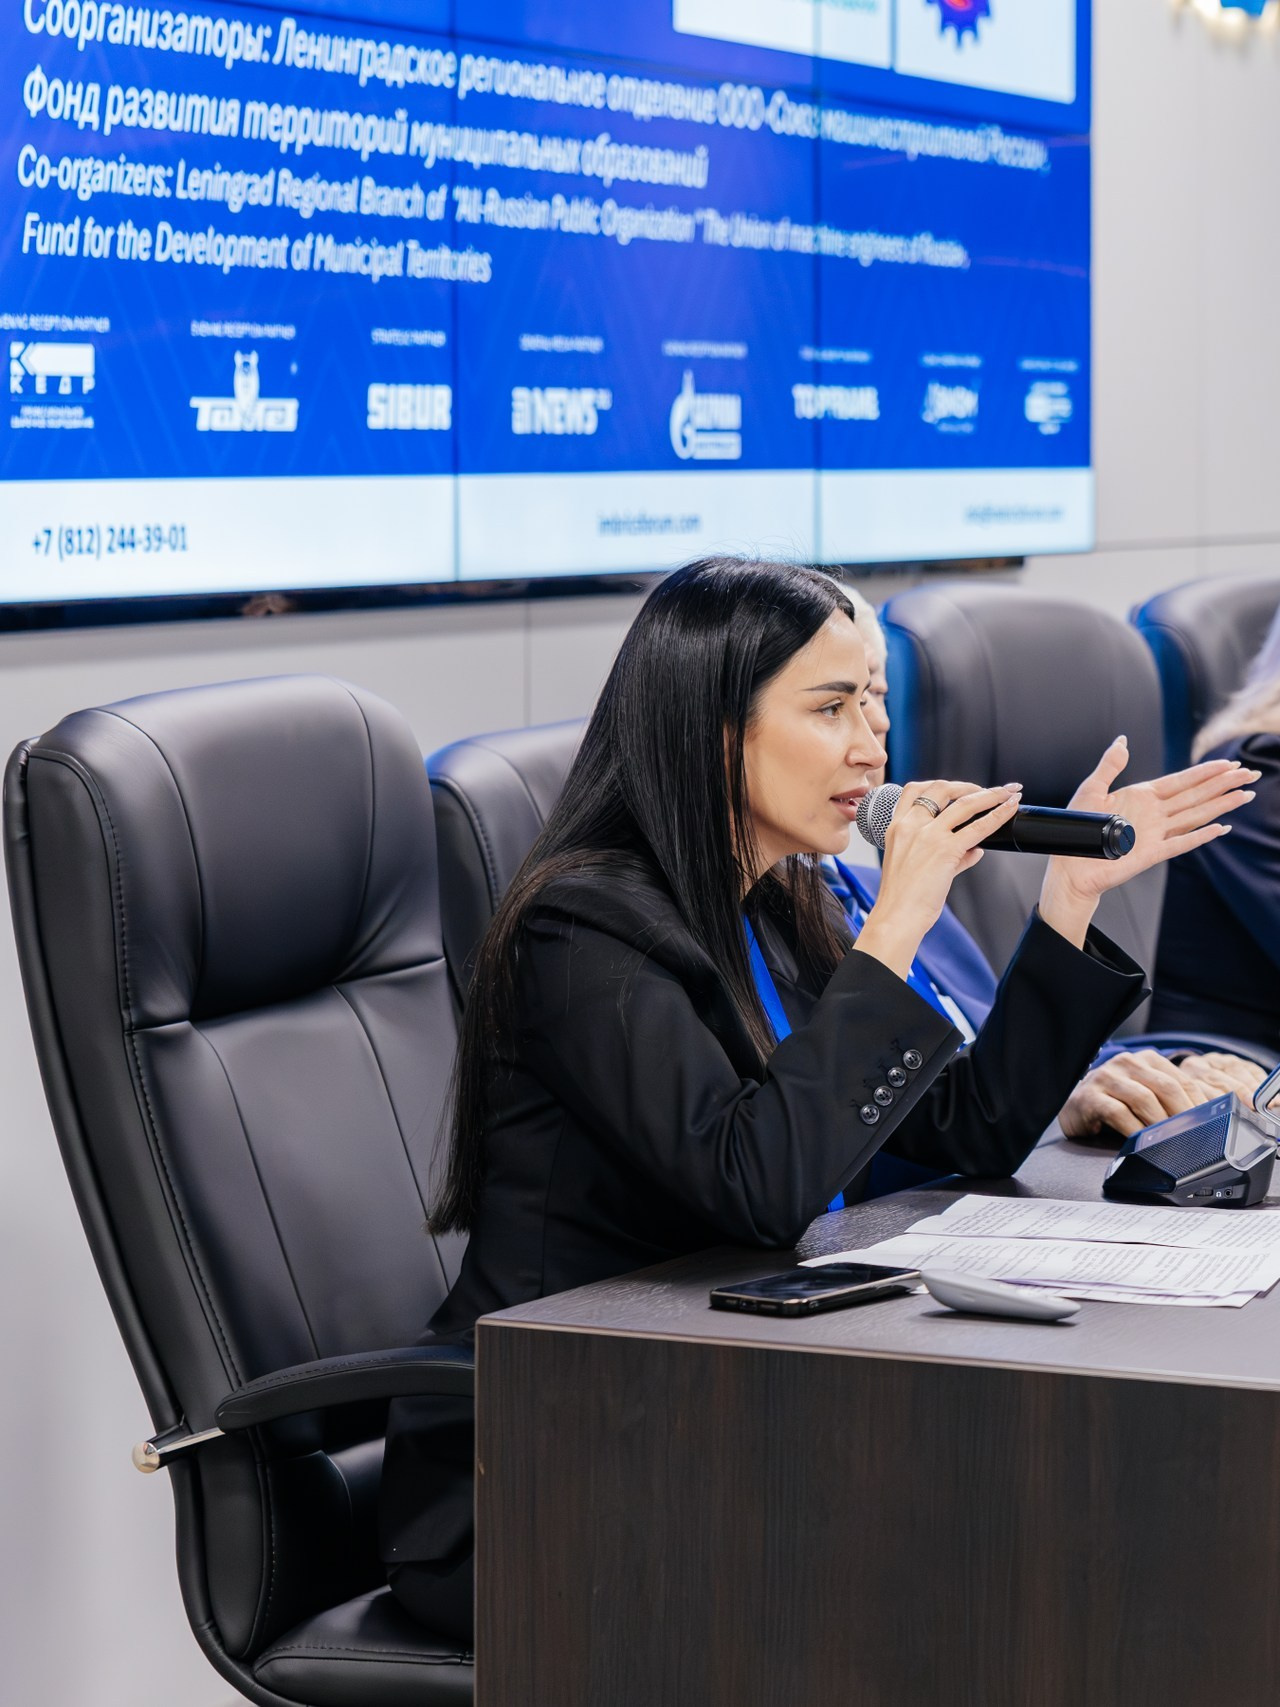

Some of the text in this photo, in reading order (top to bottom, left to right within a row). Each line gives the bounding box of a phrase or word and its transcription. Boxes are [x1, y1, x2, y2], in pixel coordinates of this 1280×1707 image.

[24, 0, 272, 70] Соорганизаторы:
[272, 17, 457, 89] Ленинградское
[457, 53, 607, 110] региональное
[23, 63, 710, 189] Фонд развития территорий муниципальных образований
[17, 143, 174, 201] Co-organizers:
[175, 157, 276, 213] Leningrad
[276, 167, 358, 219] Regional
[359, 175, 425, 219] Branch
[425, 183, 448, 221] of
[22, 211, 493, 284] Fund for the Development of Municipal Territories
[366, 382, 453, 431] SIBUR
[32, 522, 189, 563] +7 (812) 244-39-01
